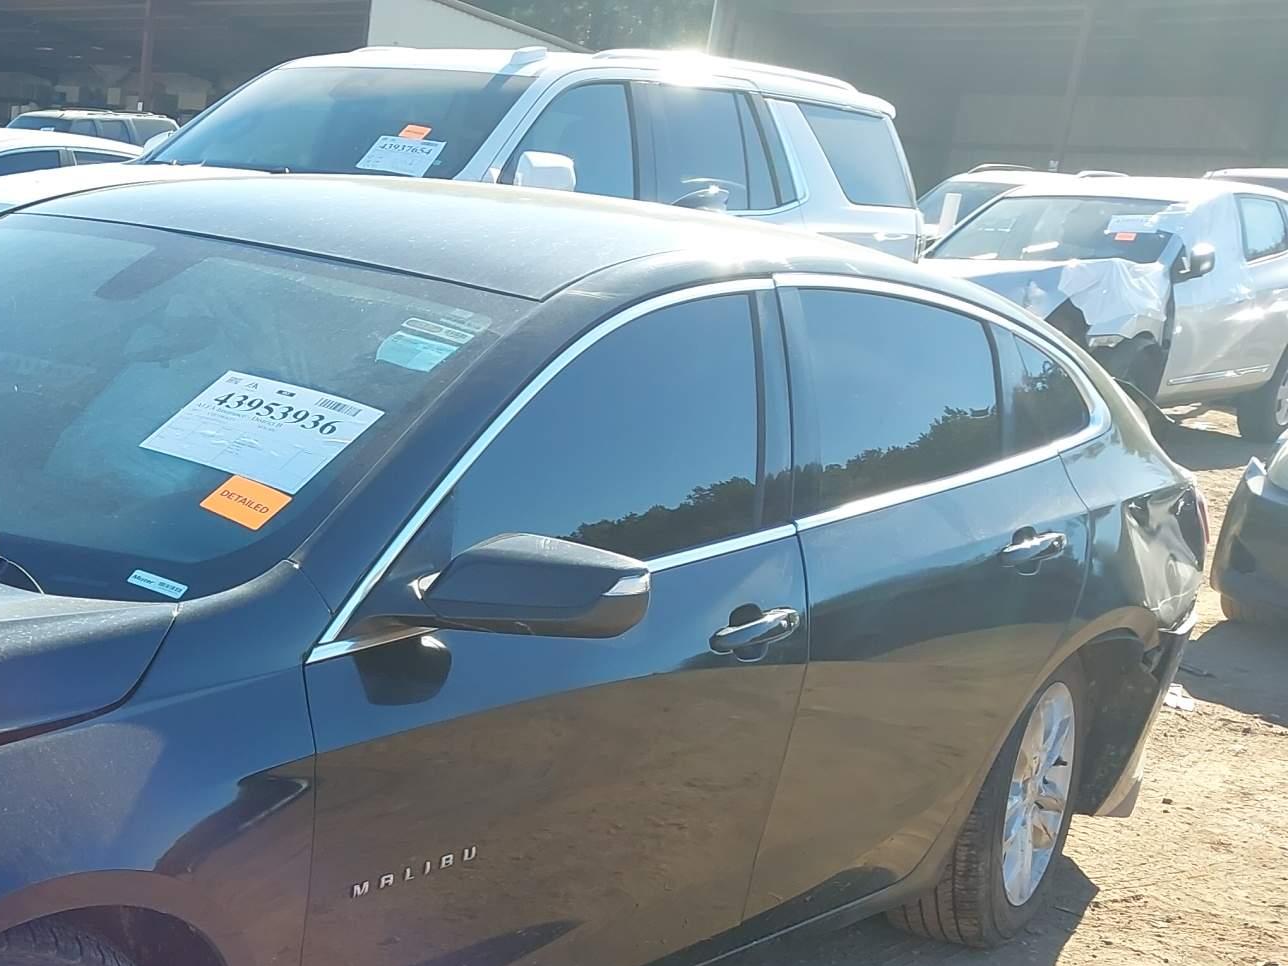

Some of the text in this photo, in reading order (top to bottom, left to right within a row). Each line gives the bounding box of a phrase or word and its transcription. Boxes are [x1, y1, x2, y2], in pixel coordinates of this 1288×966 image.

[213, 392, 339, 436] 43953936
[219, 489, 270, 514] DETAILED
[352, 846, 477, 898] MALIBU
